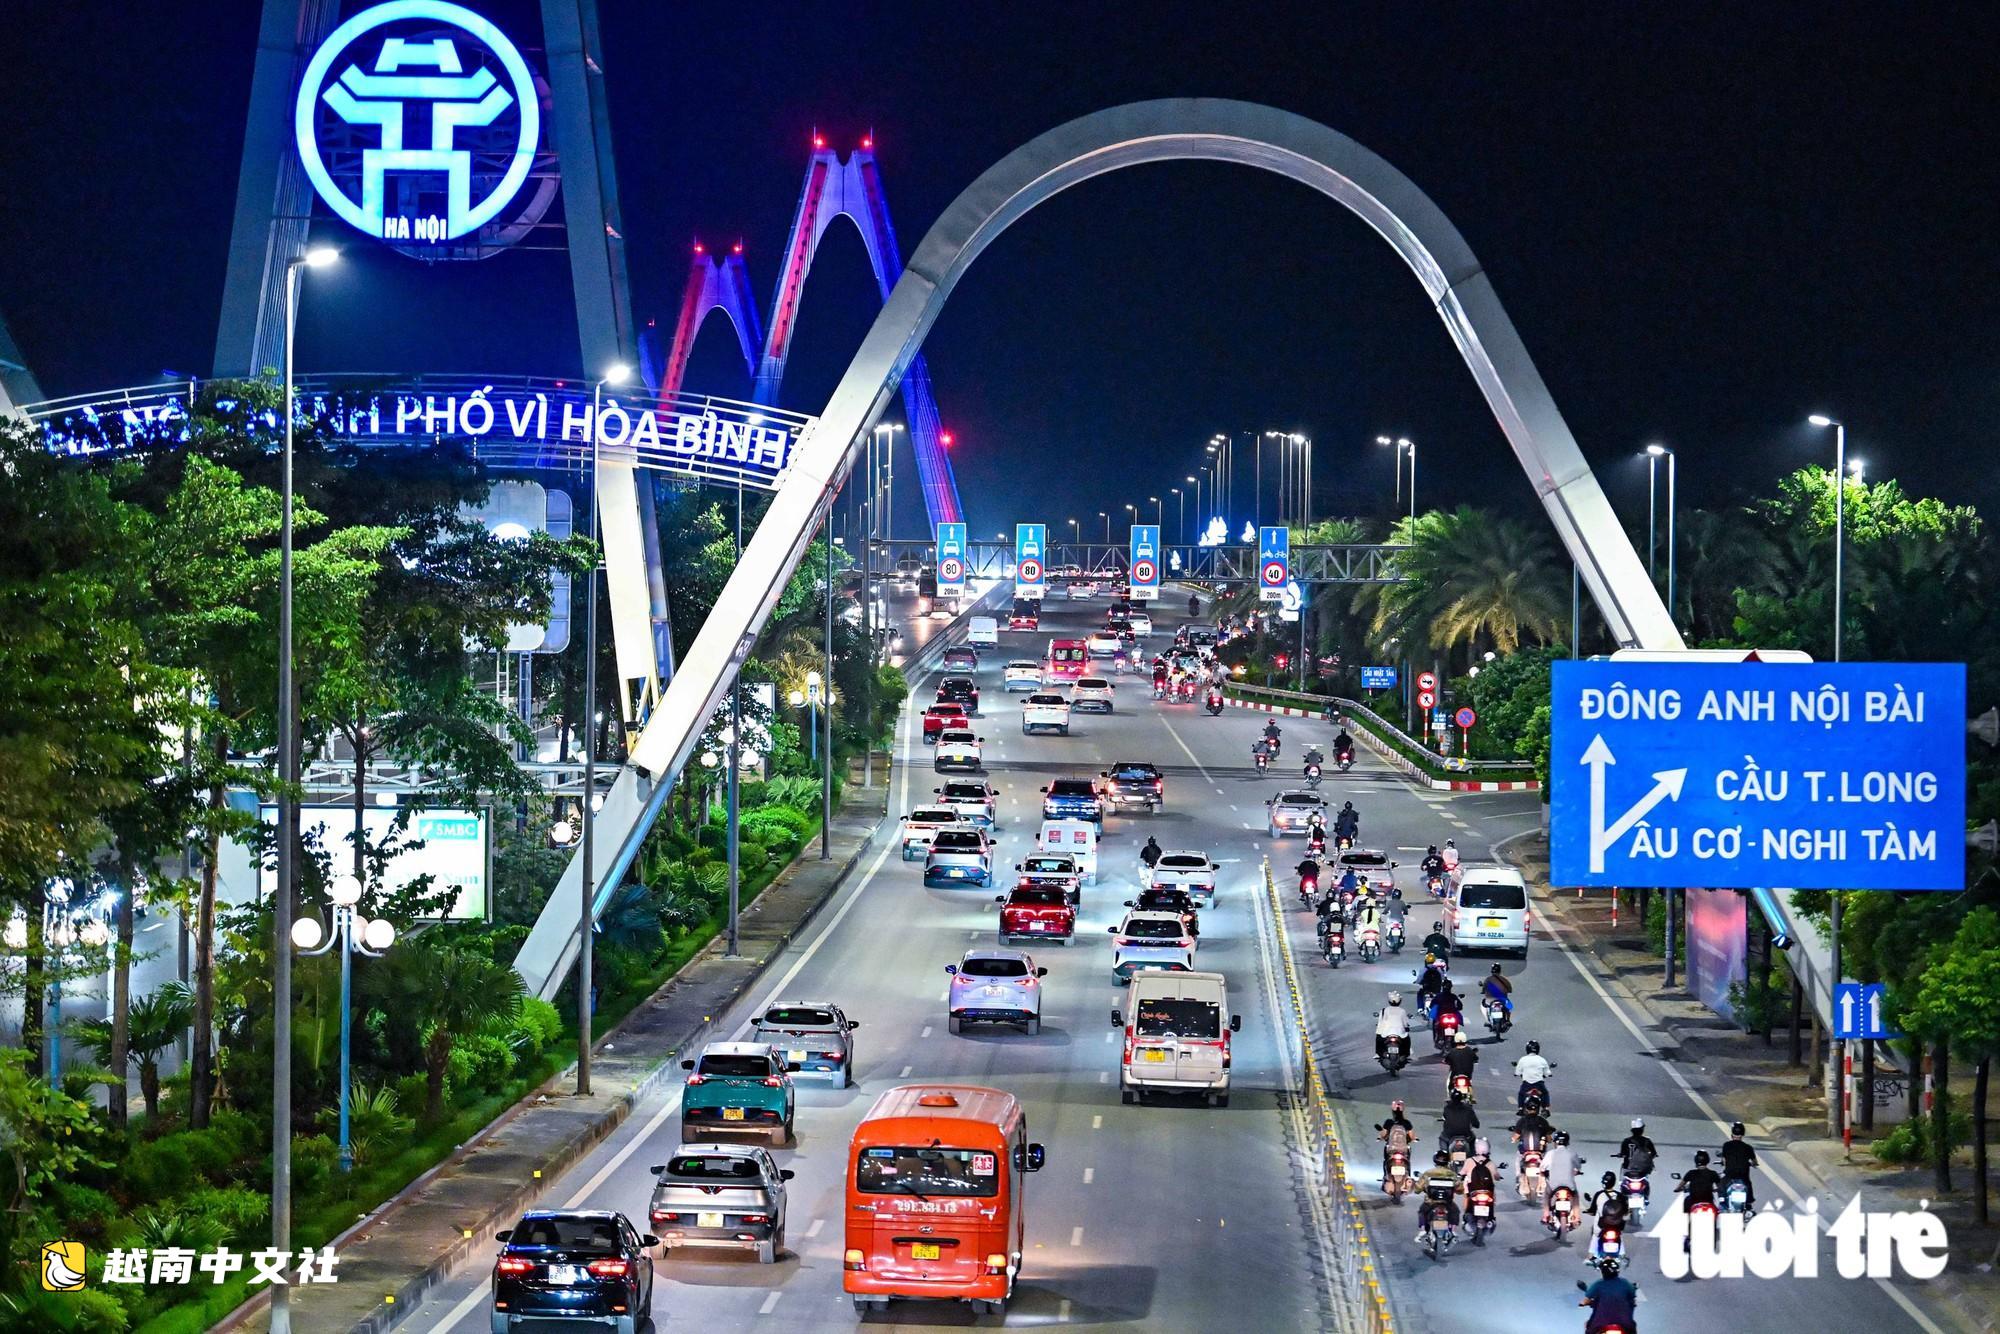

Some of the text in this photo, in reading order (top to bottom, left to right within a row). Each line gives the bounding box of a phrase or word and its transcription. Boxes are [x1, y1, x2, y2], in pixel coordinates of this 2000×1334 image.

[385, 214, 447, 244] HÀ NỘI
[396, 385, 494, 435] PHỐ
[505, 393, 548, 438] VÌ
[562, 399, 661, 449] HÒA
[676, 411, 789, 469] BÌNH
[945, 563, 957, 575] 80
[1024, 565, 1036, 576] 80
[1139, 567, 1150, 577] 80
[1268, 569, 1279, 580] 40
[1136, 590, 1151, 598] 200m
[1580, 682, 1925, 729] ĐÔNG ANH NỘI BÀI
[1716, 755, 1938, 803] CẦU T.LONG
[436, 822, 476, 837] SMBC
[1629, 820, 1678, 859] ÂU
[1861, 821, 1936, 861] TÀM
